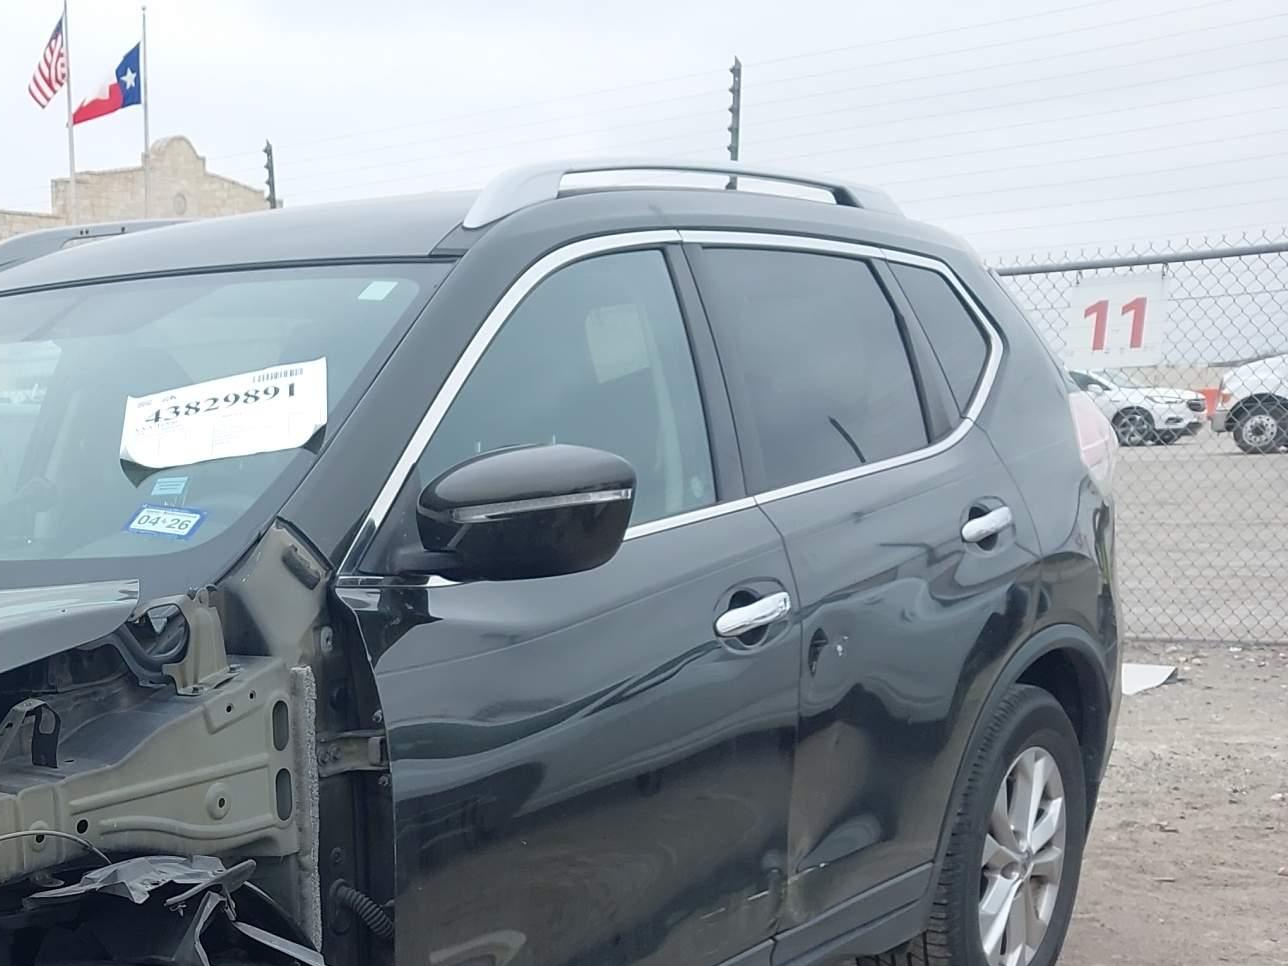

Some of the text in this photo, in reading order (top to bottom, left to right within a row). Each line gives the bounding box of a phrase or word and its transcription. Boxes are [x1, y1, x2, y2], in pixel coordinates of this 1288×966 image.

[1083, 296, 1148, 351] 11
[144, 382, 296, 423] 43829891
[137, 514, 192, 531] 04 26
